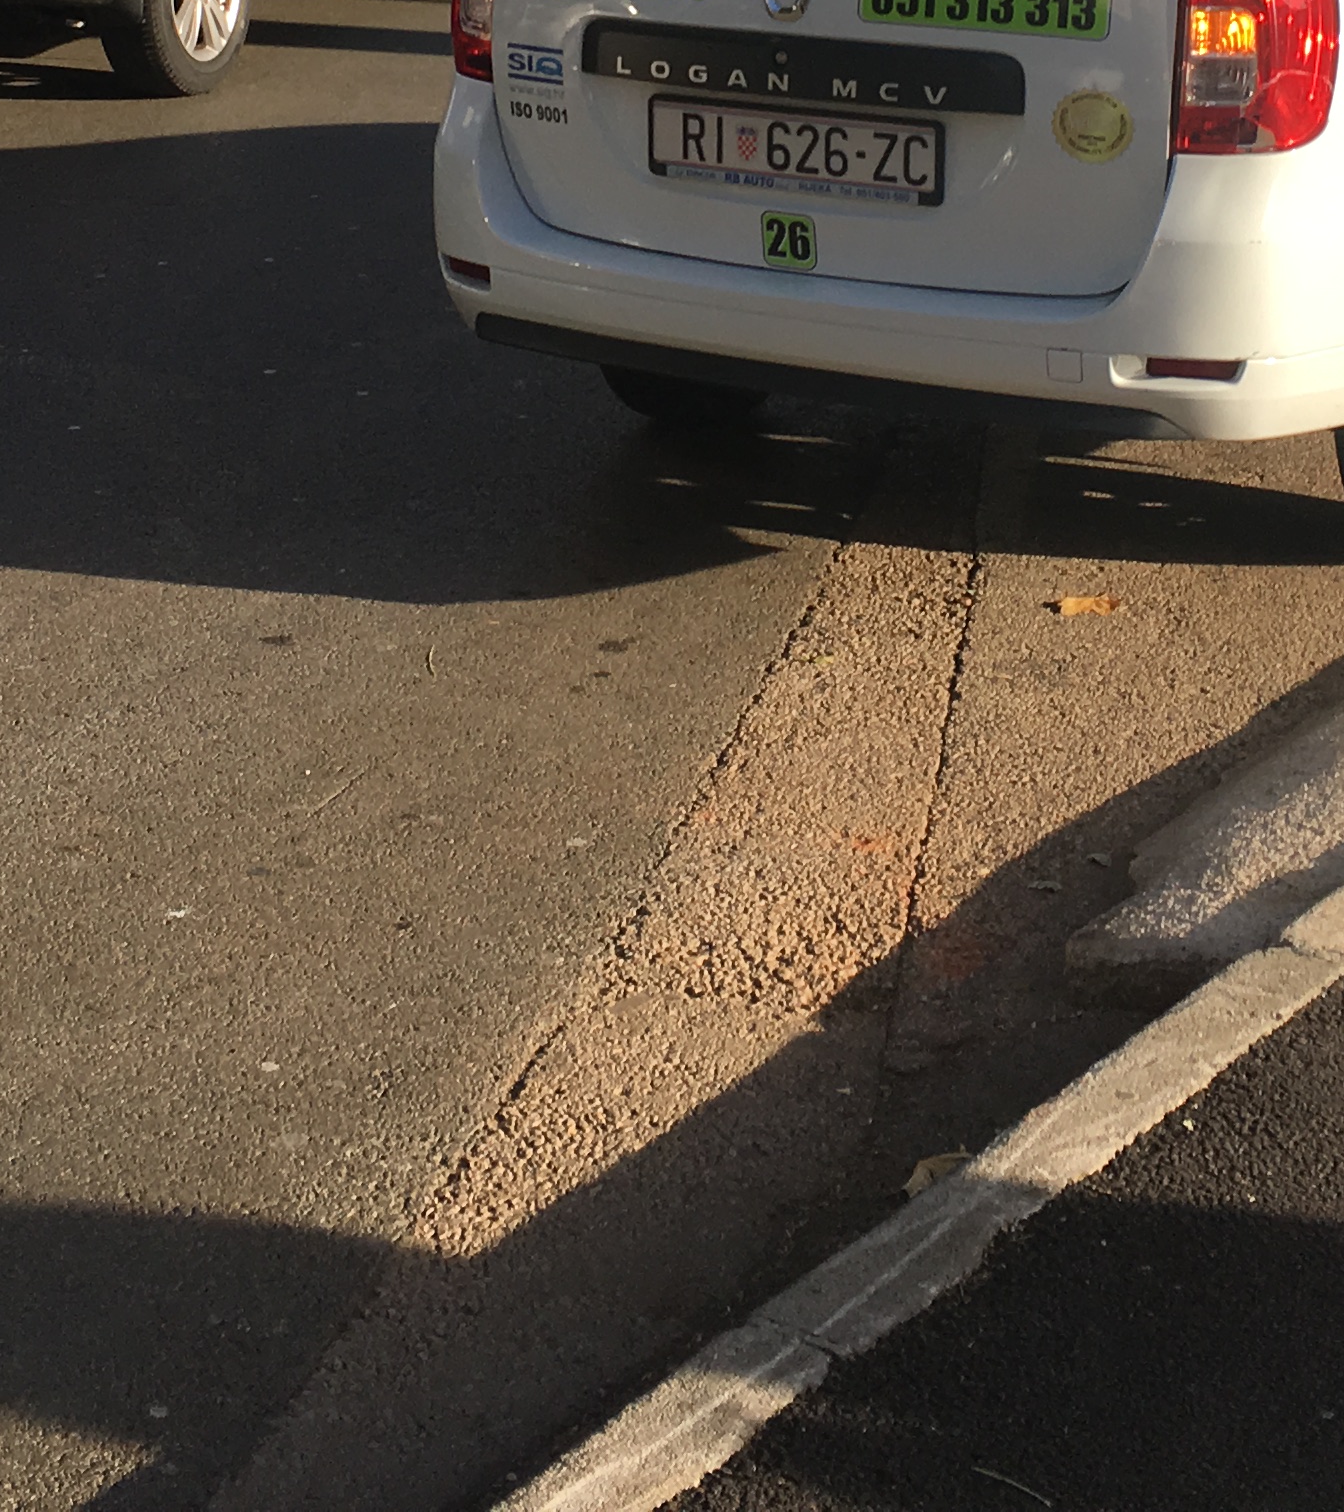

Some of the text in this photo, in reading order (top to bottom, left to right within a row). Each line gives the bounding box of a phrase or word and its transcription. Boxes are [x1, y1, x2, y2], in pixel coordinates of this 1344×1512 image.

[616, 55, 947, 105] LOGAN MCV
[510, 101, 568, 124] ISO 9001
[681, 112, 929, 187] RI 626-ZC
[743, 175, 775, 188] AUTO
[766, 217, 811, 261] 26
